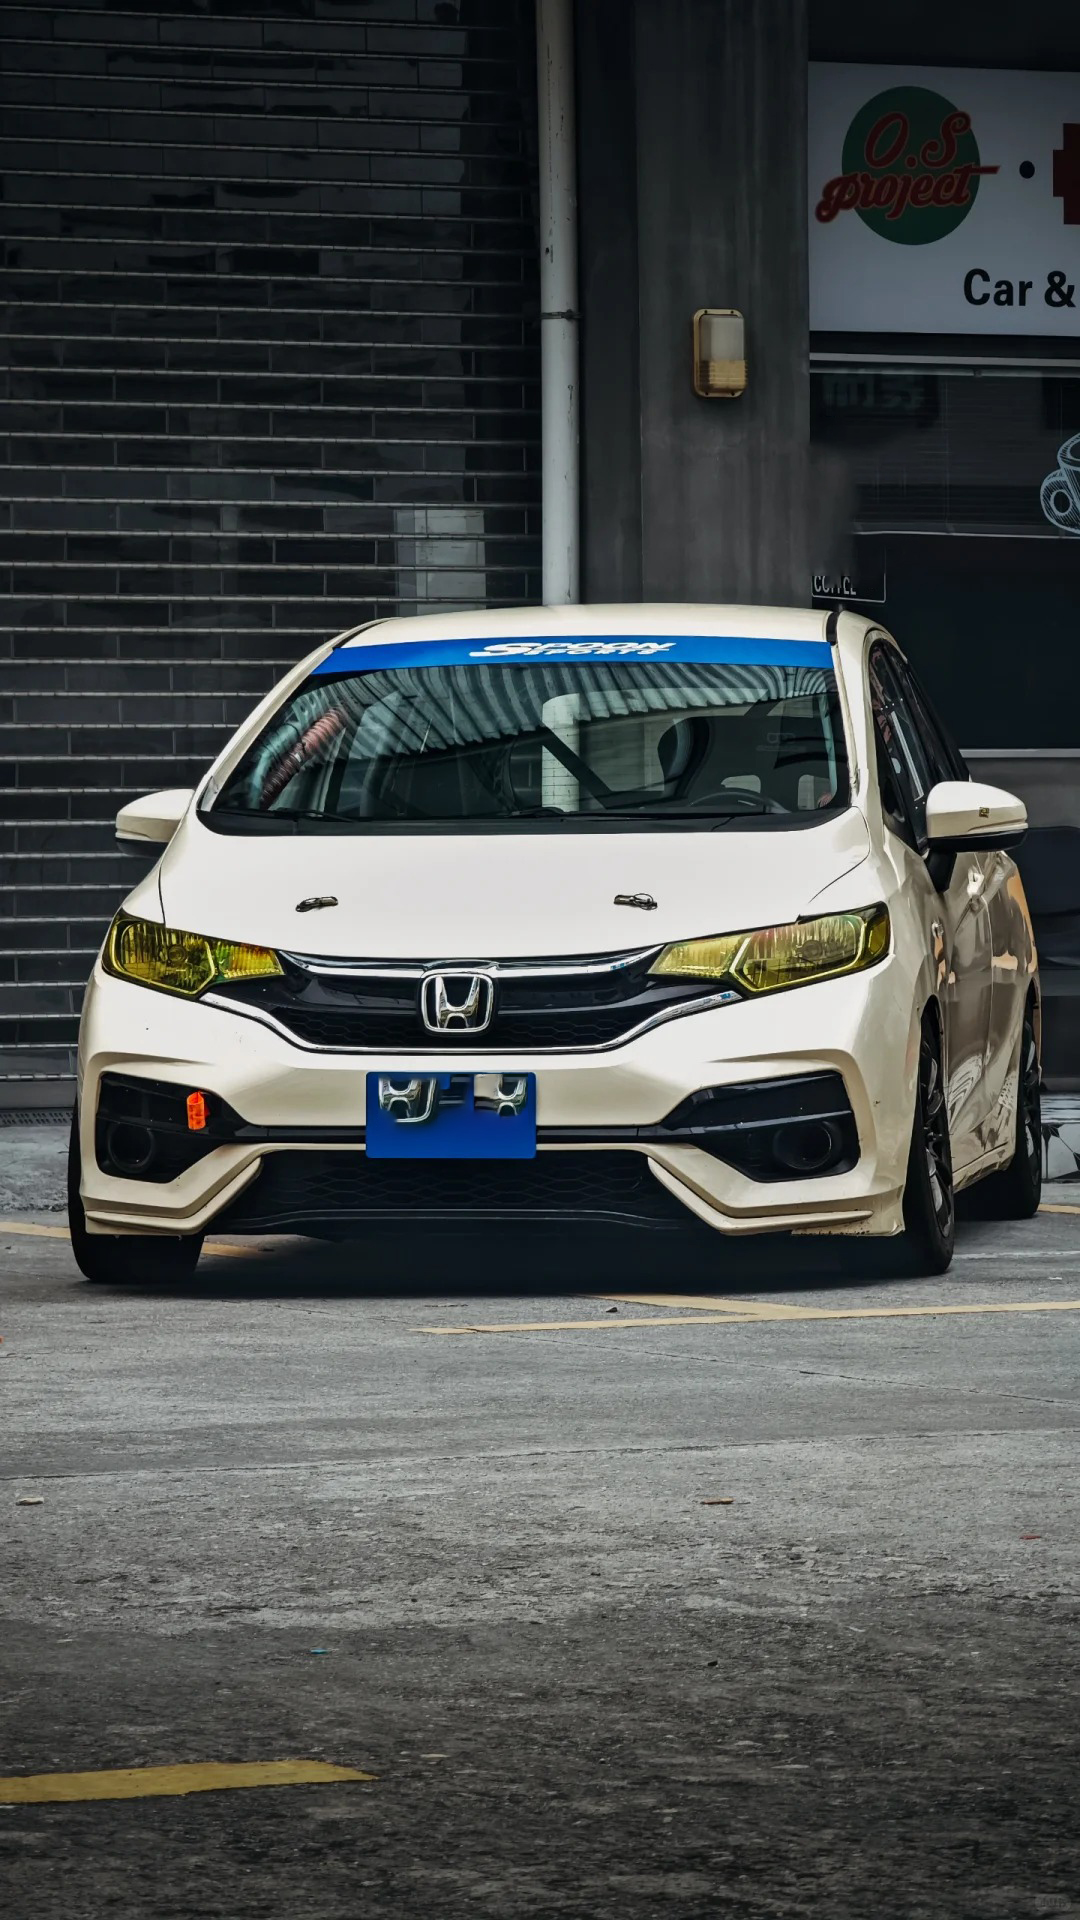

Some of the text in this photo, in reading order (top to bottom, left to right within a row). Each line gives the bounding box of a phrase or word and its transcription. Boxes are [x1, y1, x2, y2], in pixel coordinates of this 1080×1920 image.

[864, 110, 972, 170] O.S
[814, 163, 1001, 224] project
[963, 268, 1076, 308] Car &
[469, 642, 677, 657] SPOON
